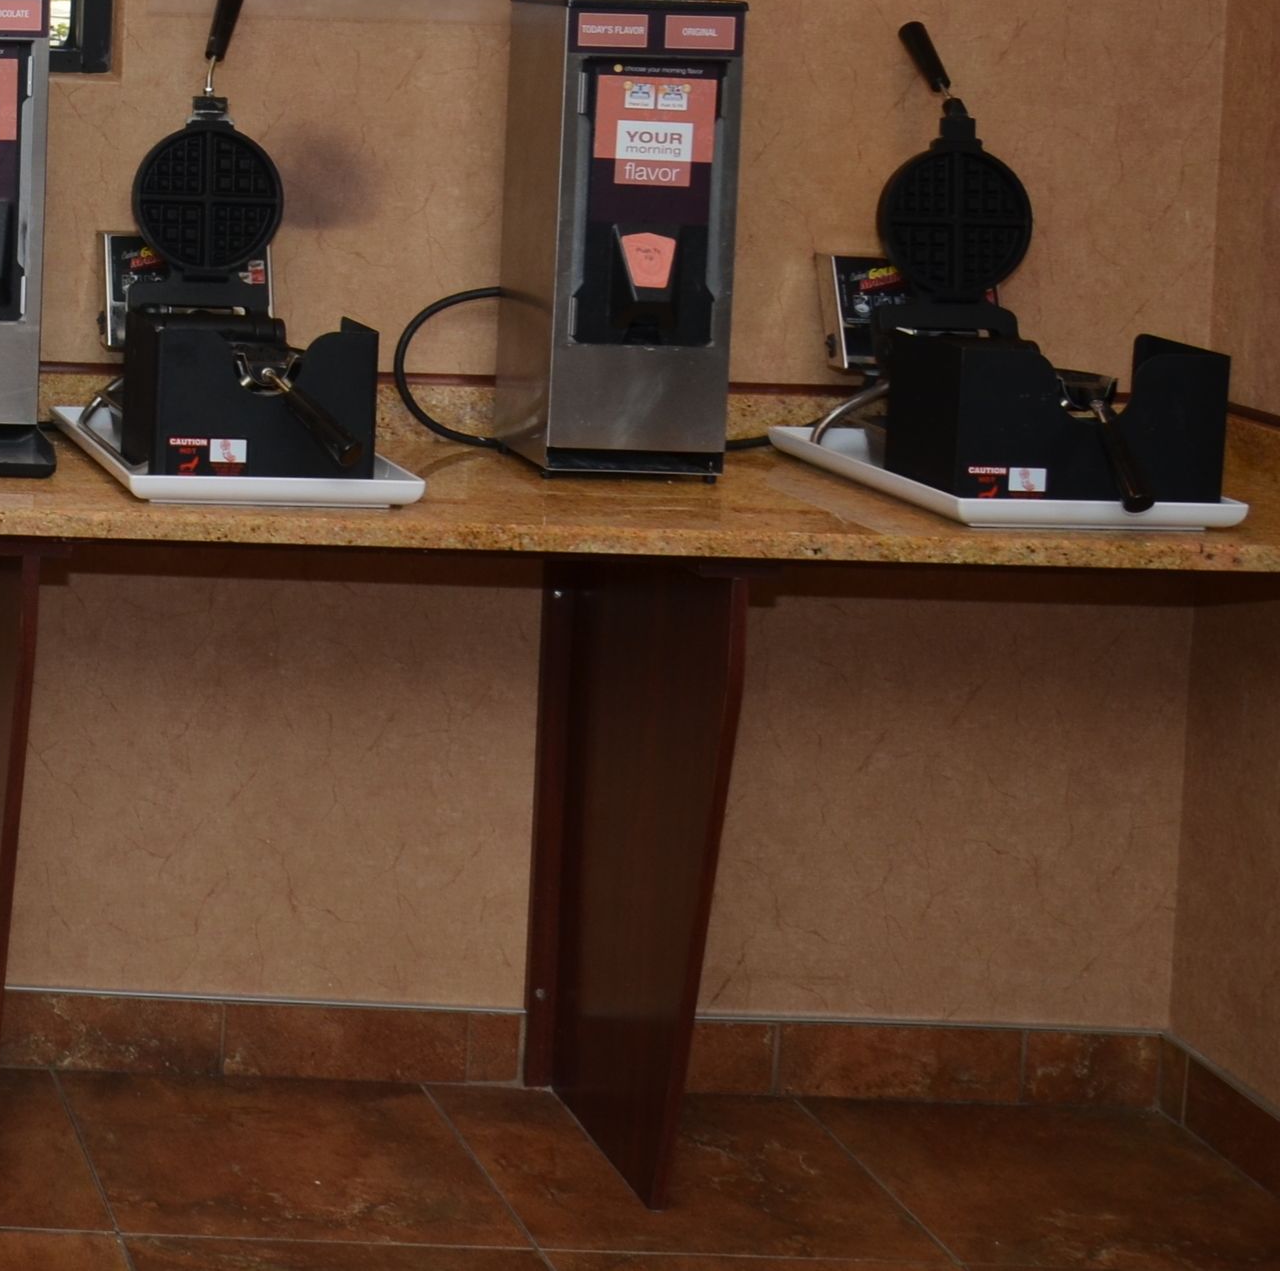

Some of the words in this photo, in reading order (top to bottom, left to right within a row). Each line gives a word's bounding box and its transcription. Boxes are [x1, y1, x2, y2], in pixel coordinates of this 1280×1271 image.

[582, 25, 613, 34] TODAY'S
[614, 26, 645, 35] FLAVOR
[682, 28, 718, 37] ORIGINAL
[662, 67, 687, 75] morning
[626, 130, 683, 145] YOUR
[625, 145, 682, 158] morning
[624, 162, 681, 182] flavor
[169, 438, 208, 446] CAUTION
[968, 467, 1007, 475] CAUTION
